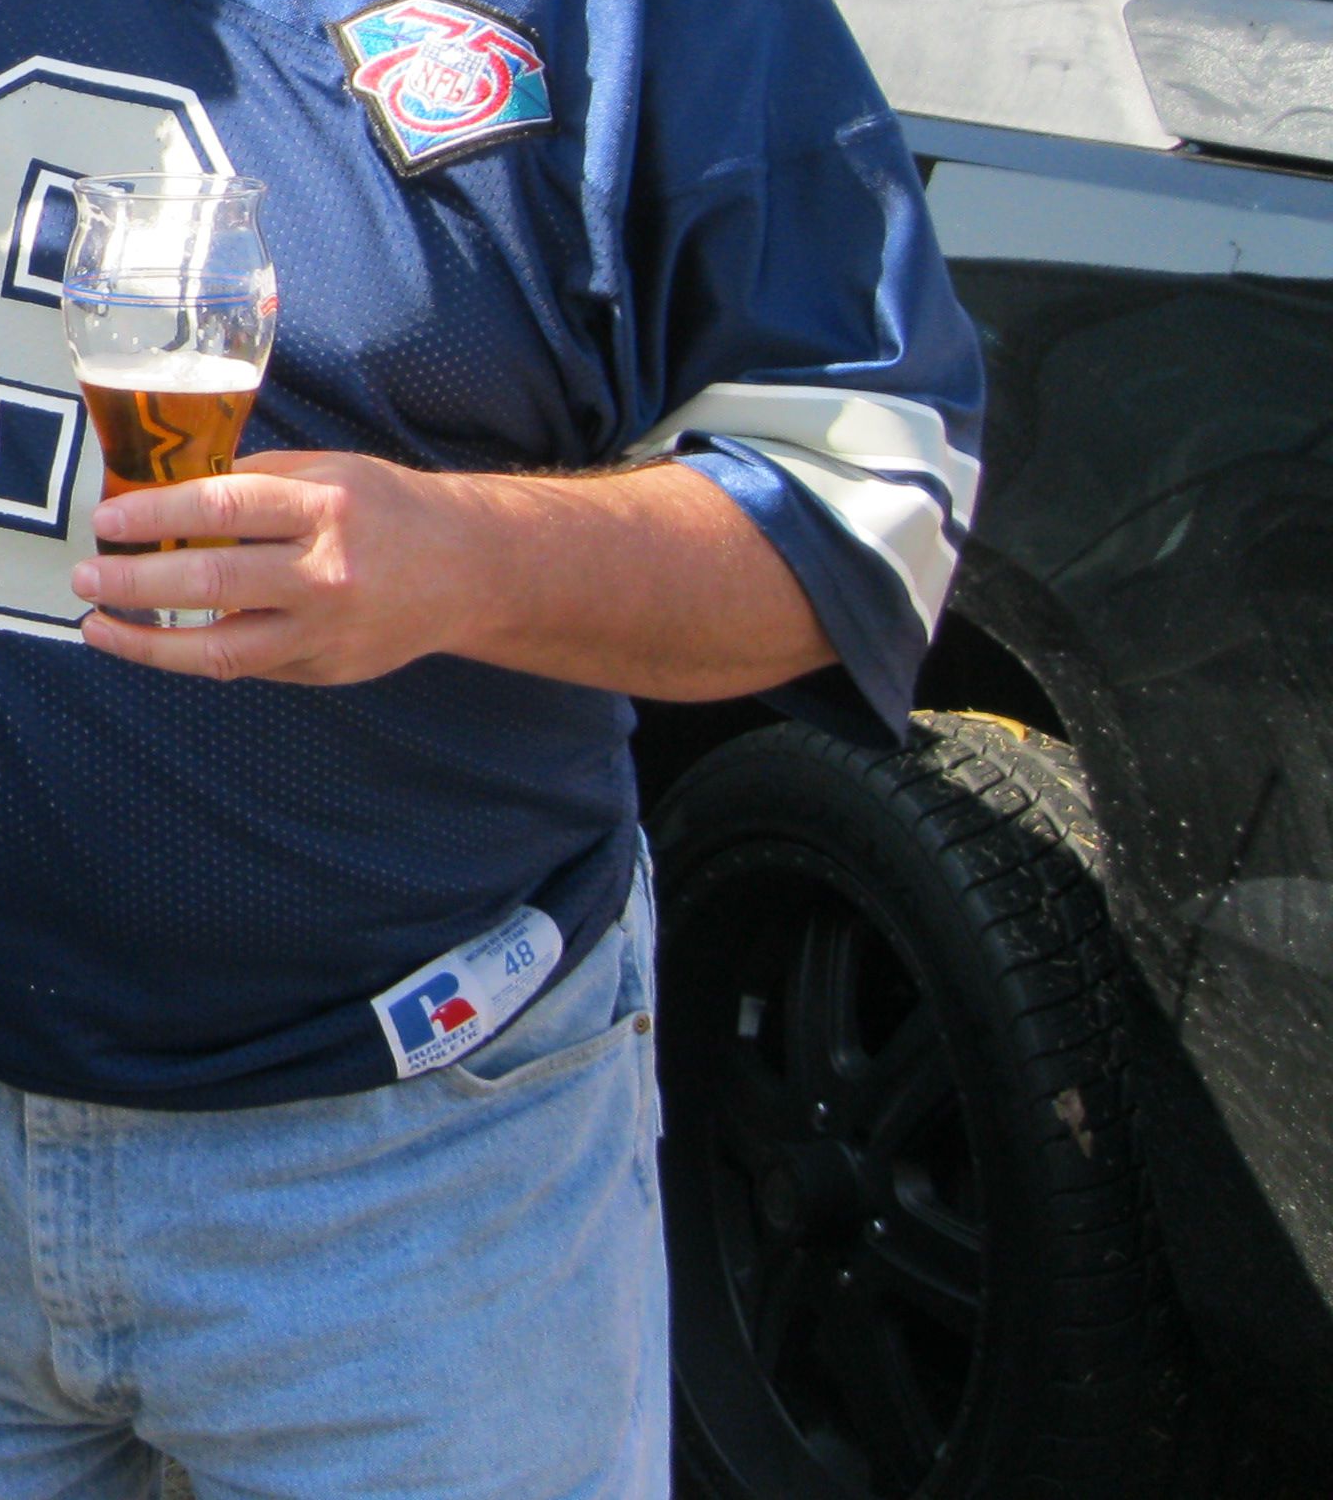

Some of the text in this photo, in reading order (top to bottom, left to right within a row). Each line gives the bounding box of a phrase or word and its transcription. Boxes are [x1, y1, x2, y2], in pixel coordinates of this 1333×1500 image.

[414, 60, 465, 104] NFL
[505, 939, 536, 976] 48
[407, 1018, 479, 1064] RUSSELL
[408, 1029, 478, 1071] ATHLETIC
